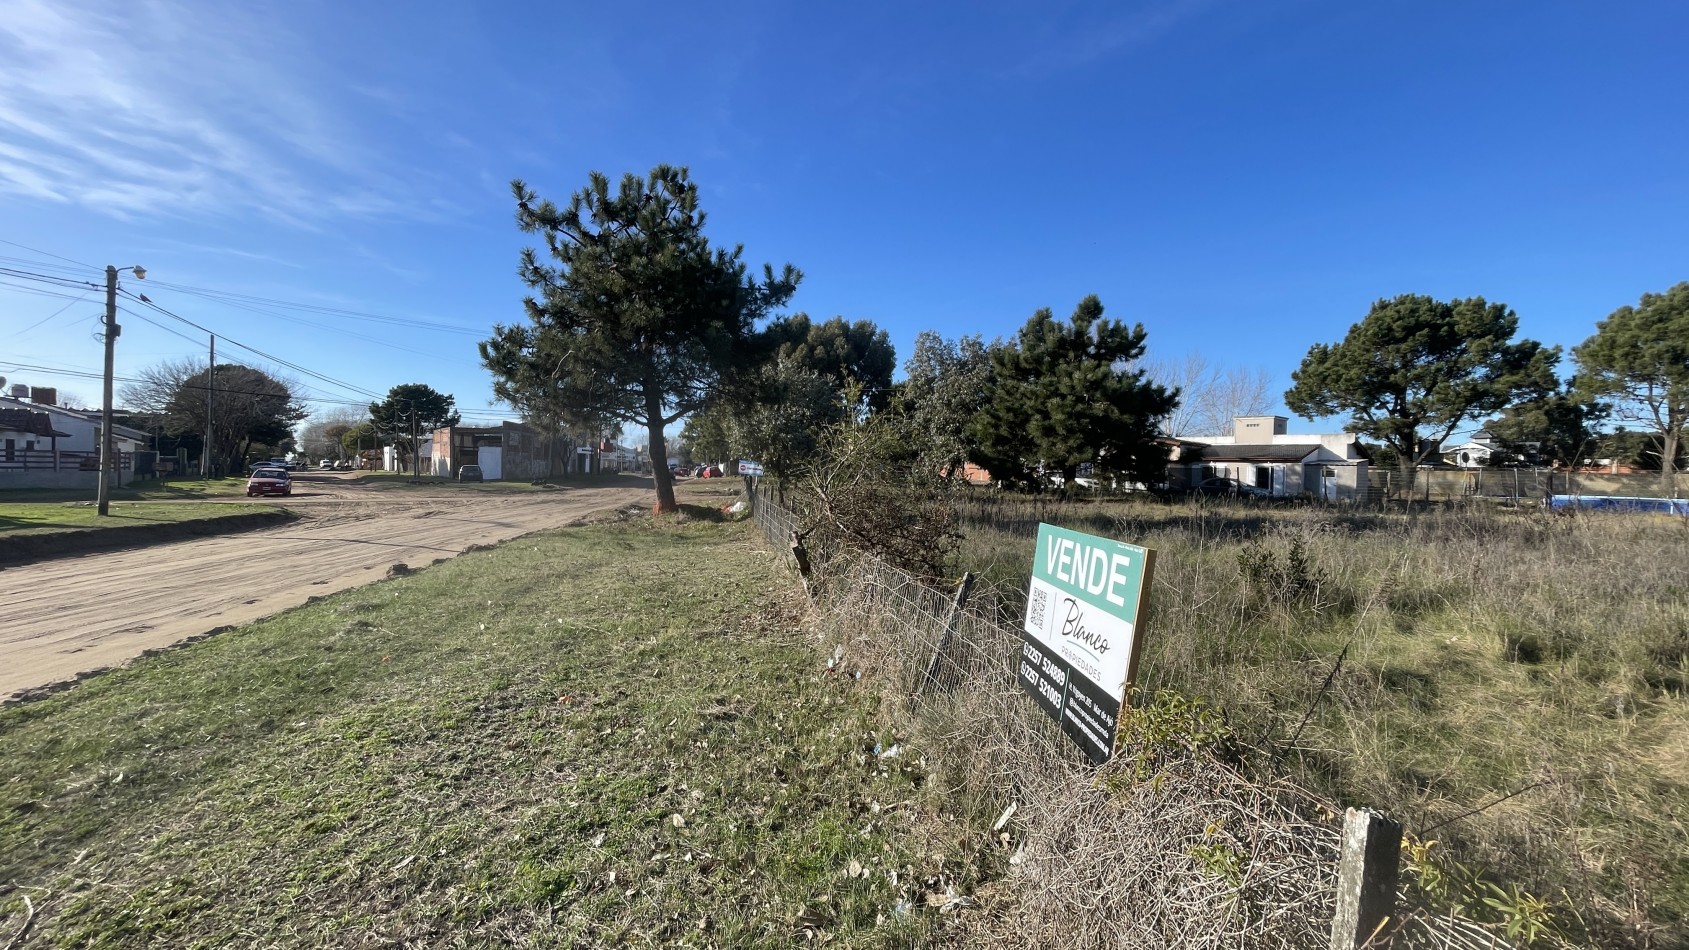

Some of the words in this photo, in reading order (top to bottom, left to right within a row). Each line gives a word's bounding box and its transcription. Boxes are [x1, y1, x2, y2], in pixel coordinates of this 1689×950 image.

[1047, 534, 1130, 607] VENDE
[1062, 598, 1110, 654] Blanco
[1028, 646, 1042, 665] 2257
[1042, 657, 1065, 686] 524889
[1061, 646, 1101, 681] PROPIEDADES
[1025, 665, 1039, 685] 2257
[1039, 678, 1062, 709] 521003
